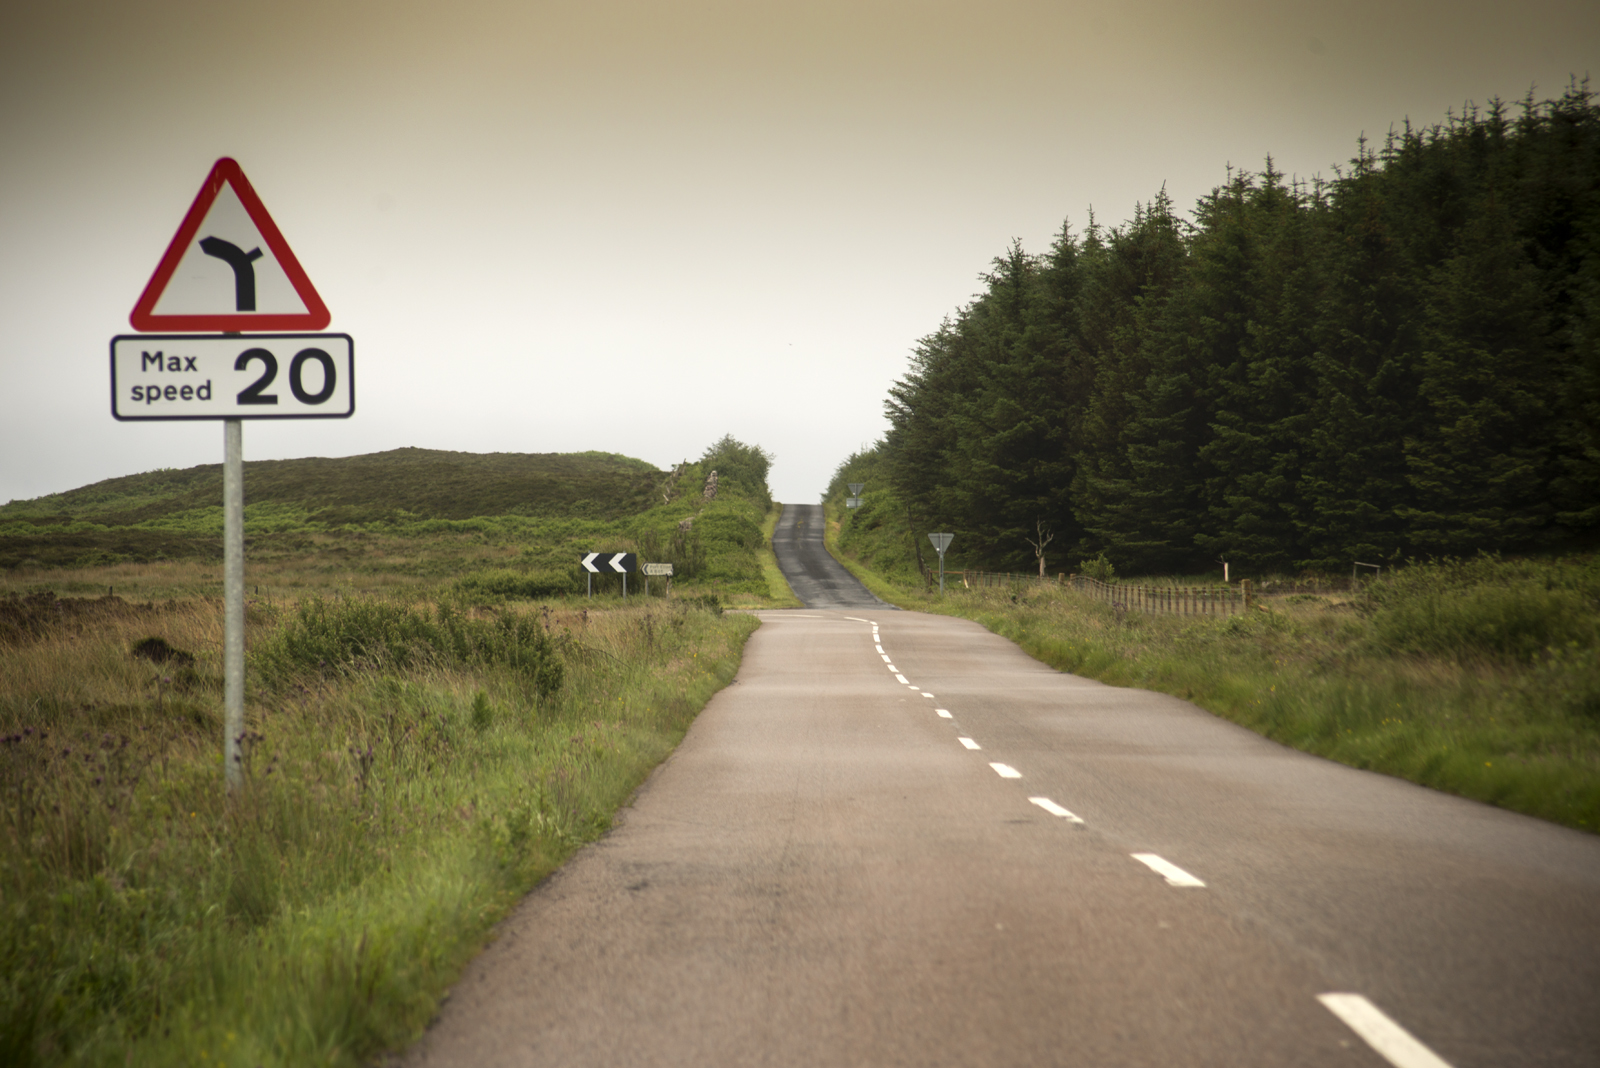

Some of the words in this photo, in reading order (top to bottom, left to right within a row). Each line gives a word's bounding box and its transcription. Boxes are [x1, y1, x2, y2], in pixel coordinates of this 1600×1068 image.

[141, 350, 198, 372] Max
[233, 347, 337, 406] 20
[131, 379, 212, 405] speed
